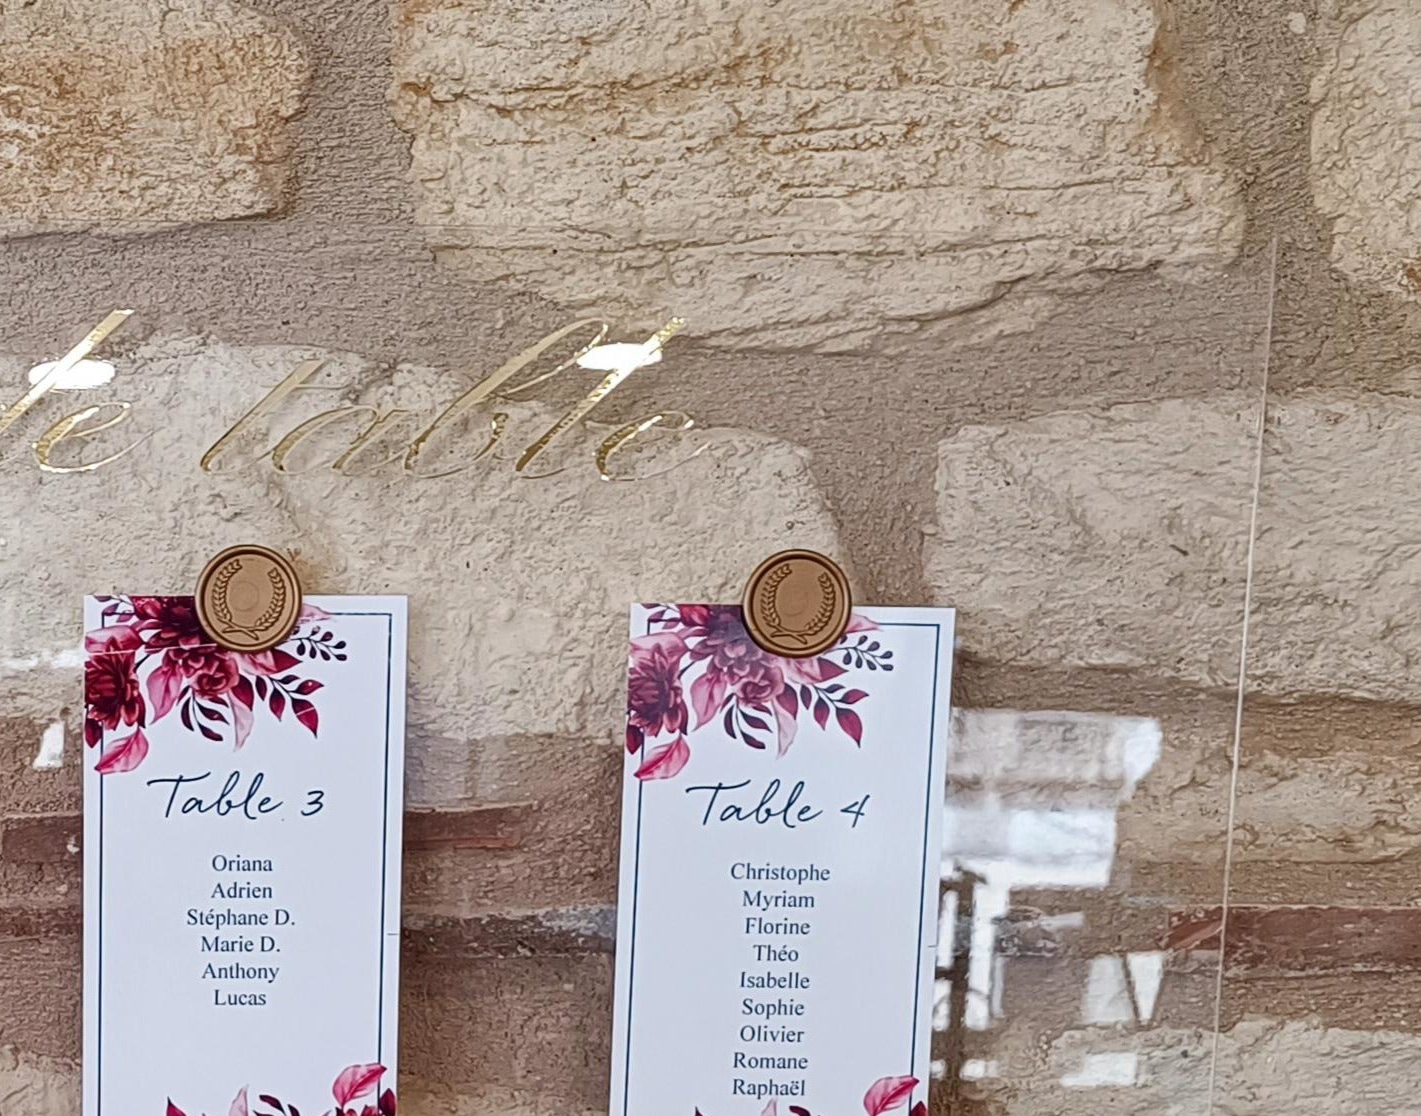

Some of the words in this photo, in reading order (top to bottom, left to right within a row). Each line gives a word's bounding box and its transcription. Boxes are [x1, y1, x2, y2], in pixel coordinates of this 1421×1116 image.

[199, 317, 711, 480] table
[146, 770, 284, 821] Table
[300, 790, 324, 816] 3
[685, 779, 823, 828] Table
[840, 794, 870, 828] 4
[212, 854, 273, 871] Oriana
[731, 863, 830, 885] Christophe
[211, 881, 272, 899] Adrien
[743, 890, 814, 911] Myriam
[187, 908, 268, 930] Stéphane
[275, 909, 295, 925] D.
[745, 917, 810, 935] Florine
[201, 935, 254, 952] Marie
[261, 936, 280, 952] D.
[753, 944, 799, 962] Théo
[202, 962, 279, 983] Anthony
[740, 971, 809, 989] Isabelle
[215, 989, 266, 1006] Lucas
[742, 998, 804, 1020] Sophie
[740, 1025, 805, 1043] Olivier
[733, 1052, 808, 1069] Romane
[733, 1079, 805, 1100] Raphaël
